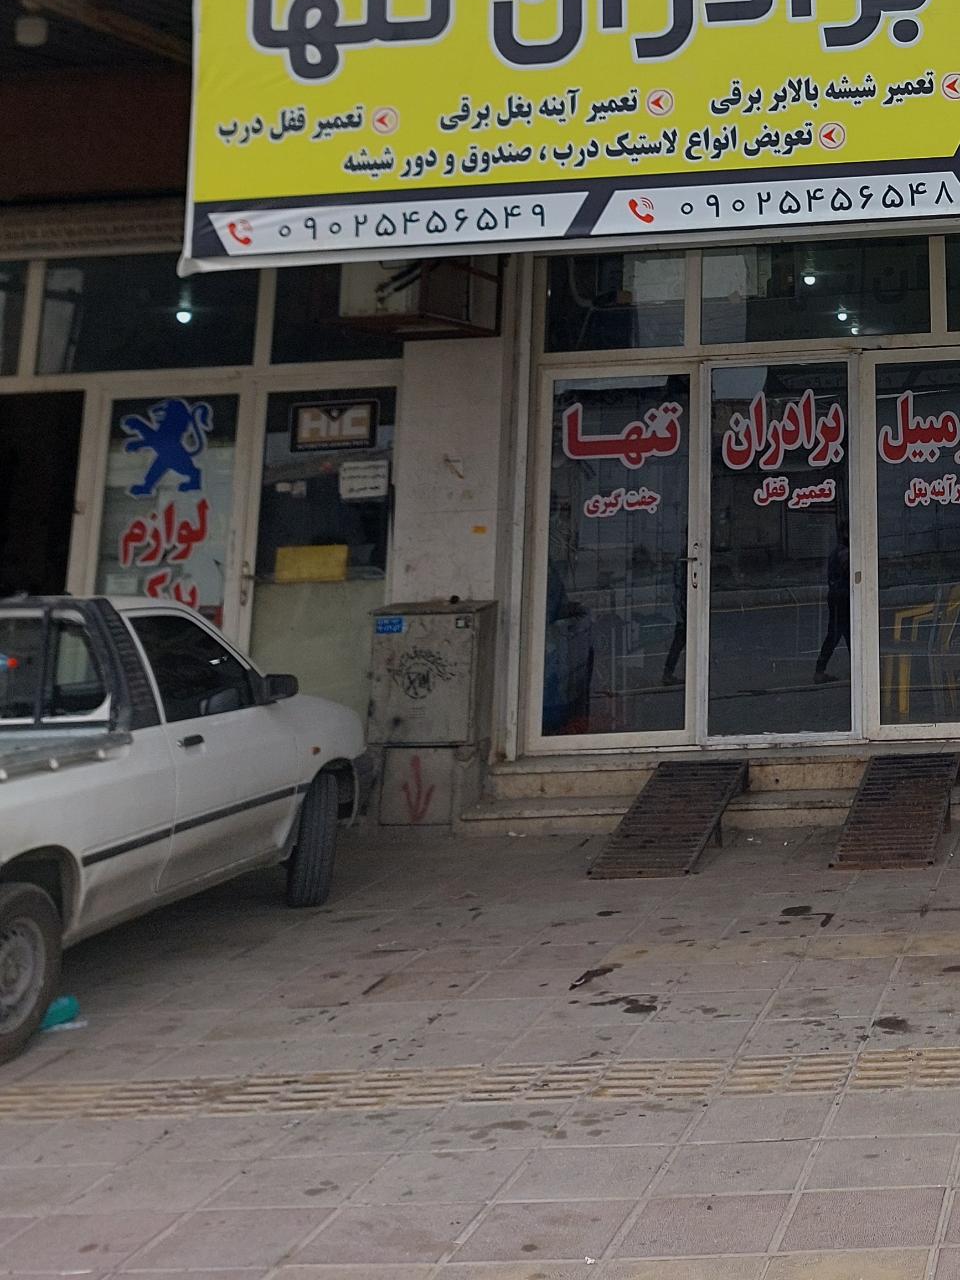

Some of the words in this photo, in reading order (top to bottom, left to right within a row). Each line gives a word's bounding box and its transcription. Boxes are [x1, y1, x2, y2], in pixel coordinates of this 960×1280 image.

[710, 79, 762, 115] برقی
[767, 76, 819, 112] بالابر
[825, 74, 877, 106] شیشه
[883, 70, 935, 105] تعمیر
[311, 105, 363, 140] تعمیر
[439, 96, 491, 131] برقی
[496, 94, 533, 128] بغل
[538, 88, 581, 123] آینه
[586, 88, 638, 123] تعمیر
[218, 116, 264, 144] درب
[269, 106, 306, 141] قفل
[743, 122, 813, 156] تعویض
[461, 142, 532, 174] صندوق
[552, 139, 599, 168] درب
[605, 128, 678, 162] لاستیک
[684, 125, 737, 160] انواع
[343, 147, 395, 178] شیشه
[399, 149, 438, 177] دور
[442, 153, 456, 175] و
[680, 179, 954, 219] ۰۹۰۲۵۴۵۶۵۴۸
[278, 203, 546, 240] ۰۹۰۲۵۴۵۶۵۴۹
[563, 402, 682, 468] تنها
[723, 388, 843, 470] برادران
[584, 489, 625, 517] گیری
[624, 487, 660, 514] جفت
[754, 477, 789, 506] قفل
[789, 479, 836, 509] تعمیر
[905, 479, 929, 507] بغل
[929, 474, 955, 504] آینه
[121, 498, 209, 565] لوازم
